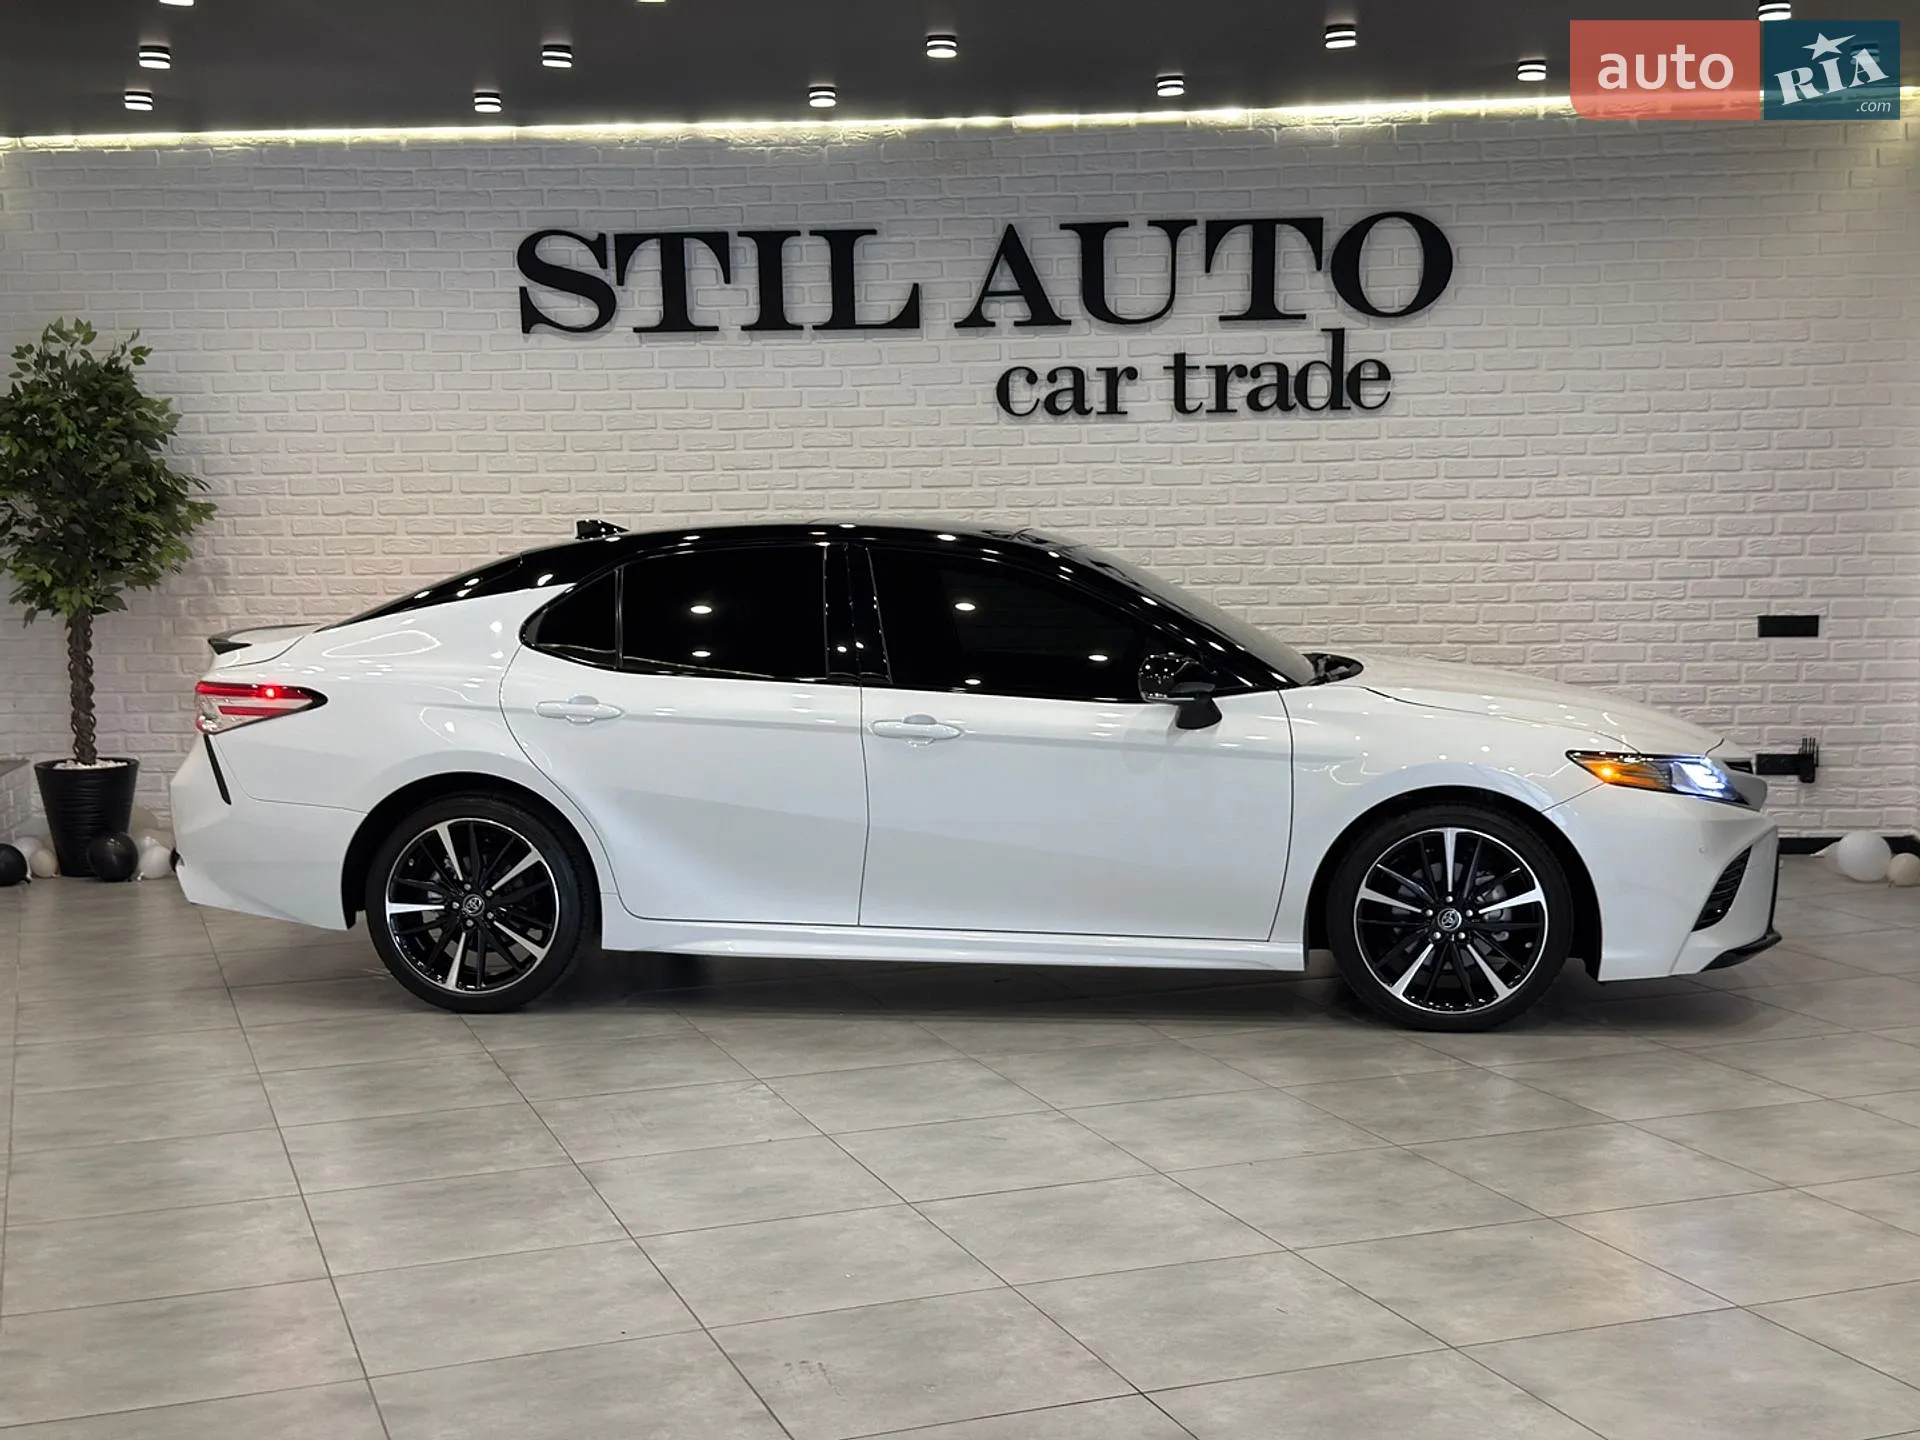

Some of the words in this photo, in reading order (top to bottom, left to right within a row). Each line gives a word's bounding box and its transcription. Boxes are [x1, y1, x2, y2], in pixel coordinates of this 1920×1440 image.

[516, 228, 921, 335] STIL
[953, 210, 1454, 329] AUTO
[995, 366, 1139, 417] car
[1162, 327, 1392, 415] trade
